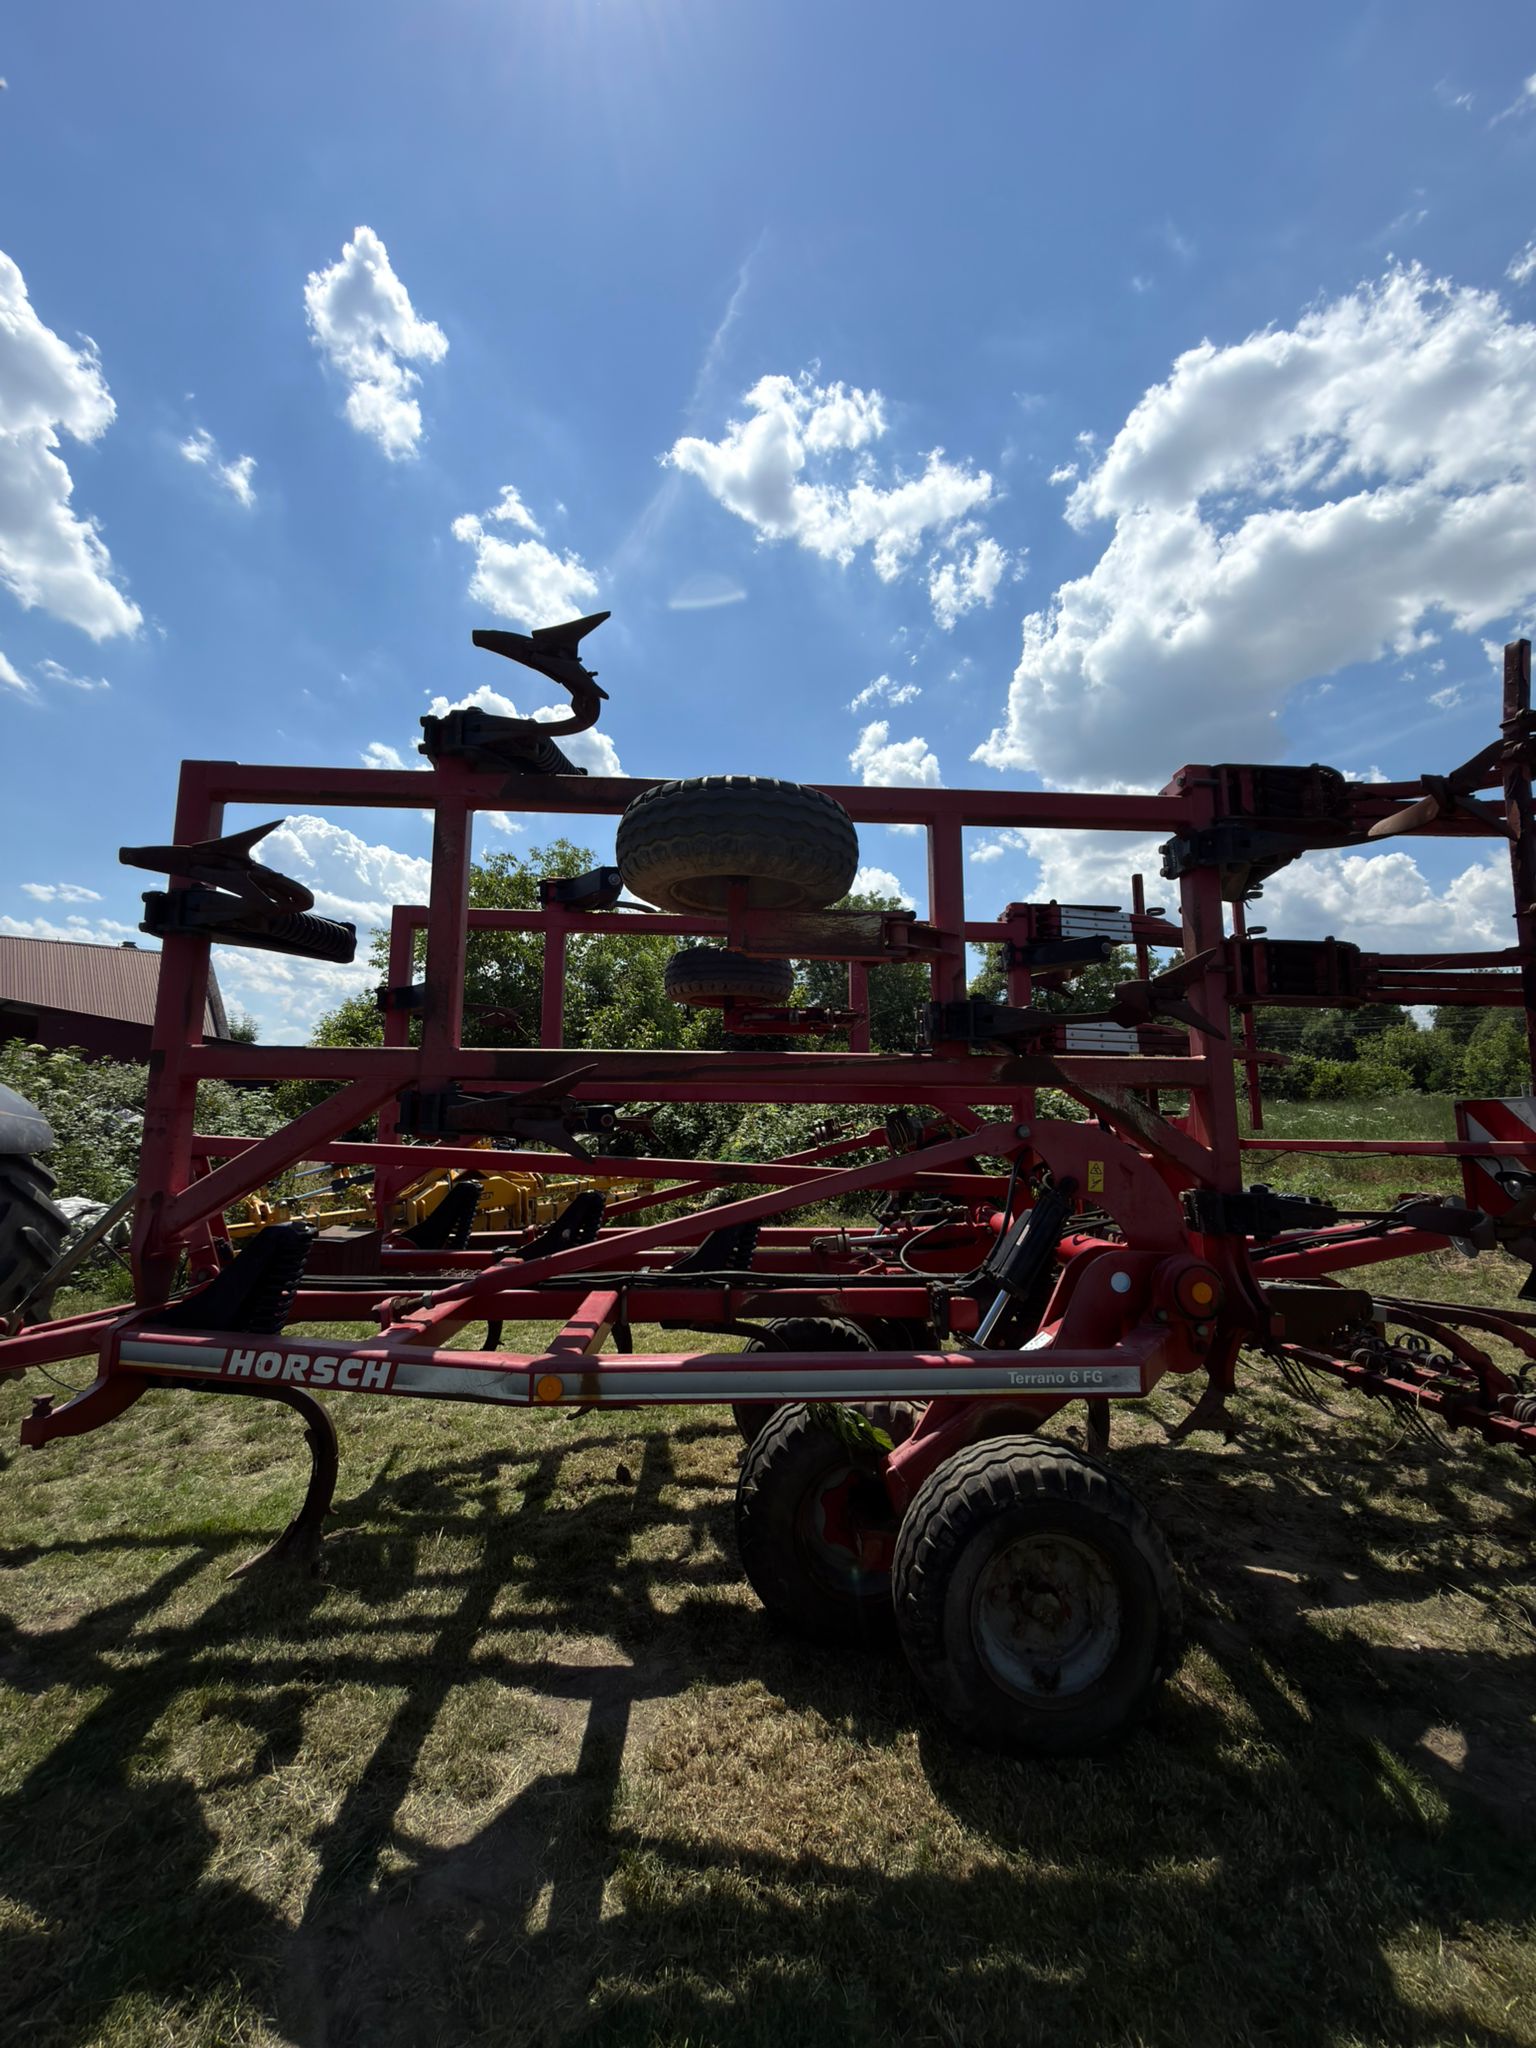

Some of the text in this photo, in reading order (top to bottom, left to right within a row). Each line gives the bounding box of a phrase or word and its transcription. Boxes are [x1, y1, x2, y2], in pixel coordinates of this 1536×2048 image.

[227, 1349, 391, 1389] HORSCH
[1008, 1370, 1103, 1385] Terrano 6 FG
